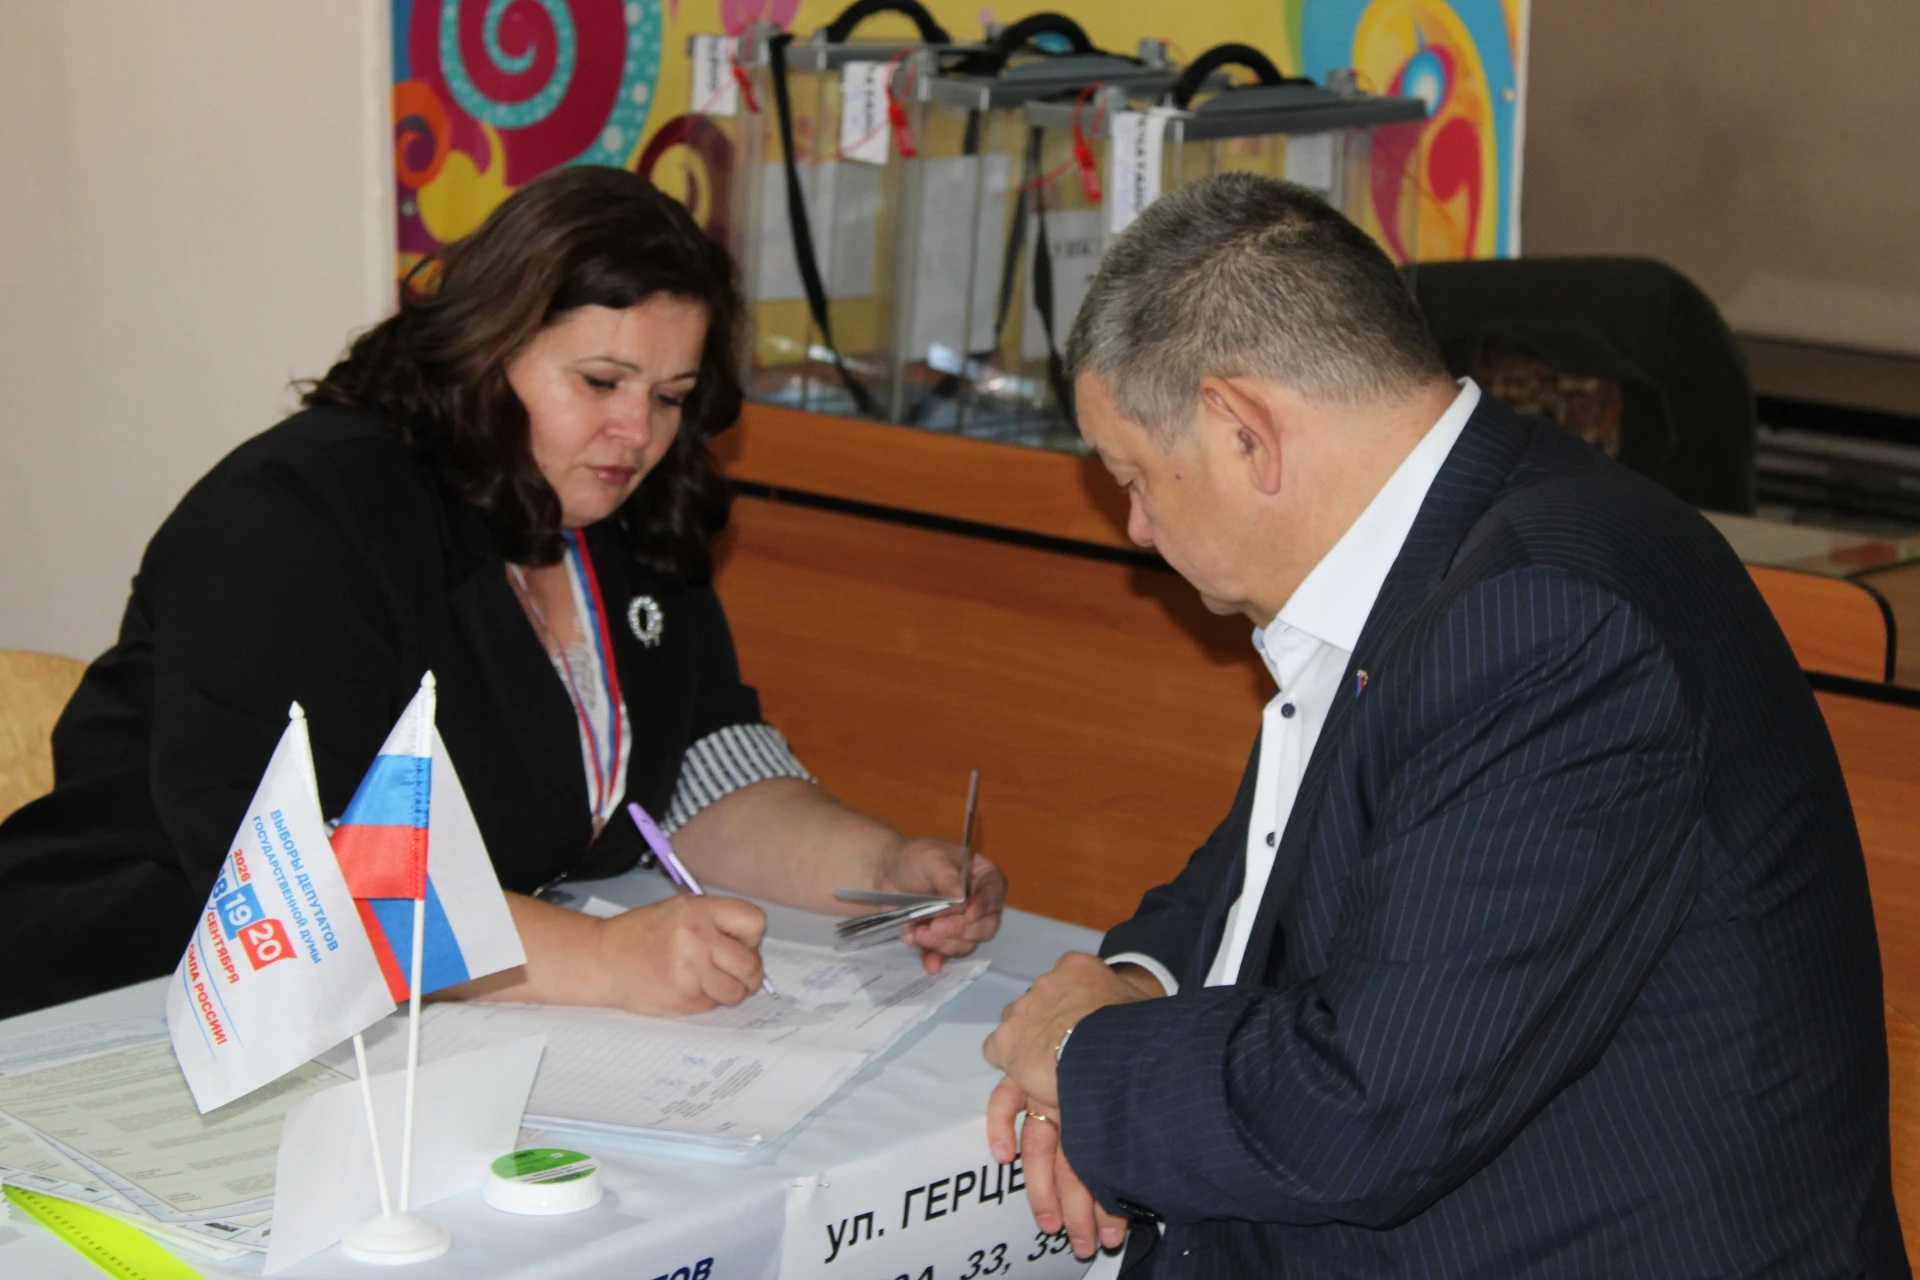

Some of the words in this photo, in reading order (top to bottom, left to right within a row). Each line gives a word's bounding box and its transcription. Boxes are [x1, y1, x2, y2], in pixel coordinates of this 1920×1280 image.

[233, 848, 251, 882] 2026
[252, 815, 308, 931] ГОСУДАРСТВЕННОЙ
[299, 927, 322, 964] ДУМЫ
[270, 809, 303, 873] ВЫБОРЫ
[295, 870, 339, 951] ДЕПУТАТОВ
[206, 911, 240, 984] СЕНТЯБРЯ
[224, 892, 252, 926] 19
[247, 922, 282, 962] 20
[193, 982, 228, 1045] РОССИИ!
[825, 1211, 885, 1264] ул.
